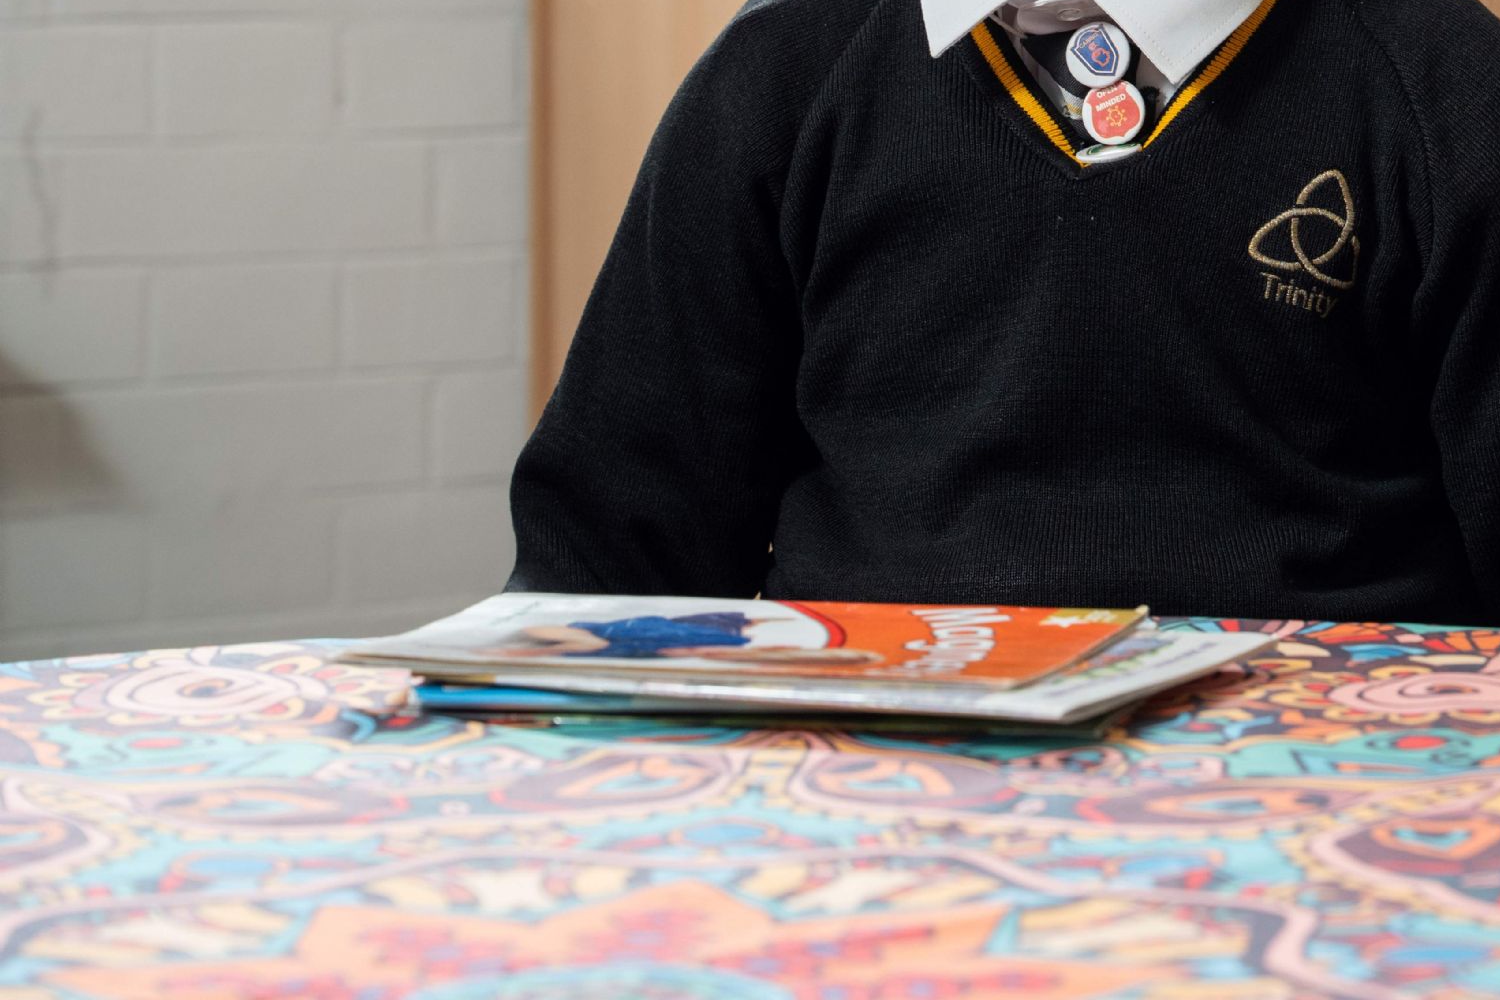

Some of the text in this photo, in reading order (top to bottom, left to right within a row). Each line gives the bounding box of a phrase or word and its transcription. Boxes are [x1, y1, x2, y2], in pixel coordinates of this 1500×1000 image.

[1096, 85, 1118, 99] OPEN
[1095, 93, 1127, 113] MINDED
[1259, 271, 1338, 319] Trinity
